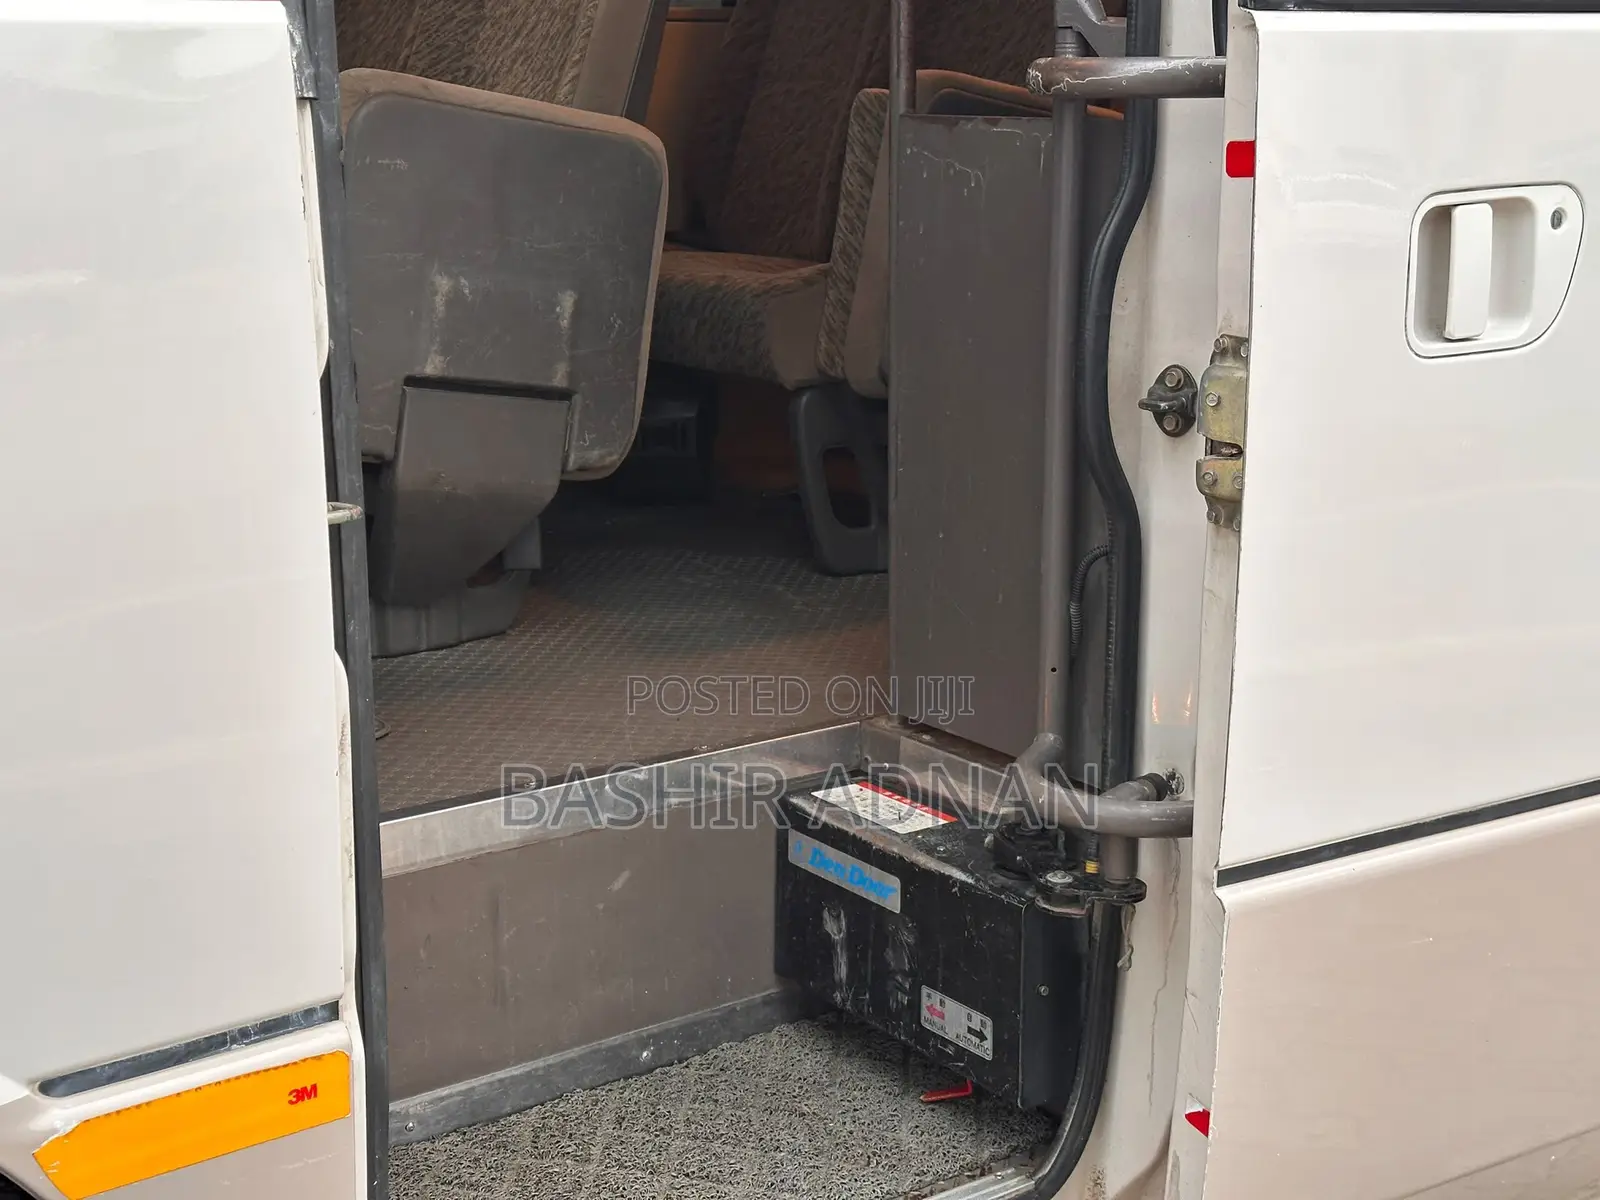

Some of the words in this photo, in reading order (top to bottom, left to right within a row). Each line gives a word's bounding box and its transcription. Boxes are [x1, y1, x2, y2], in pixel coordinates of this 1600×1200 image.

[923, 1015, 949, 1036] MANUAL
[955, 1032, 990, 1057] AUTOMATIC
[287, 1082, 318, 1106] 3M
